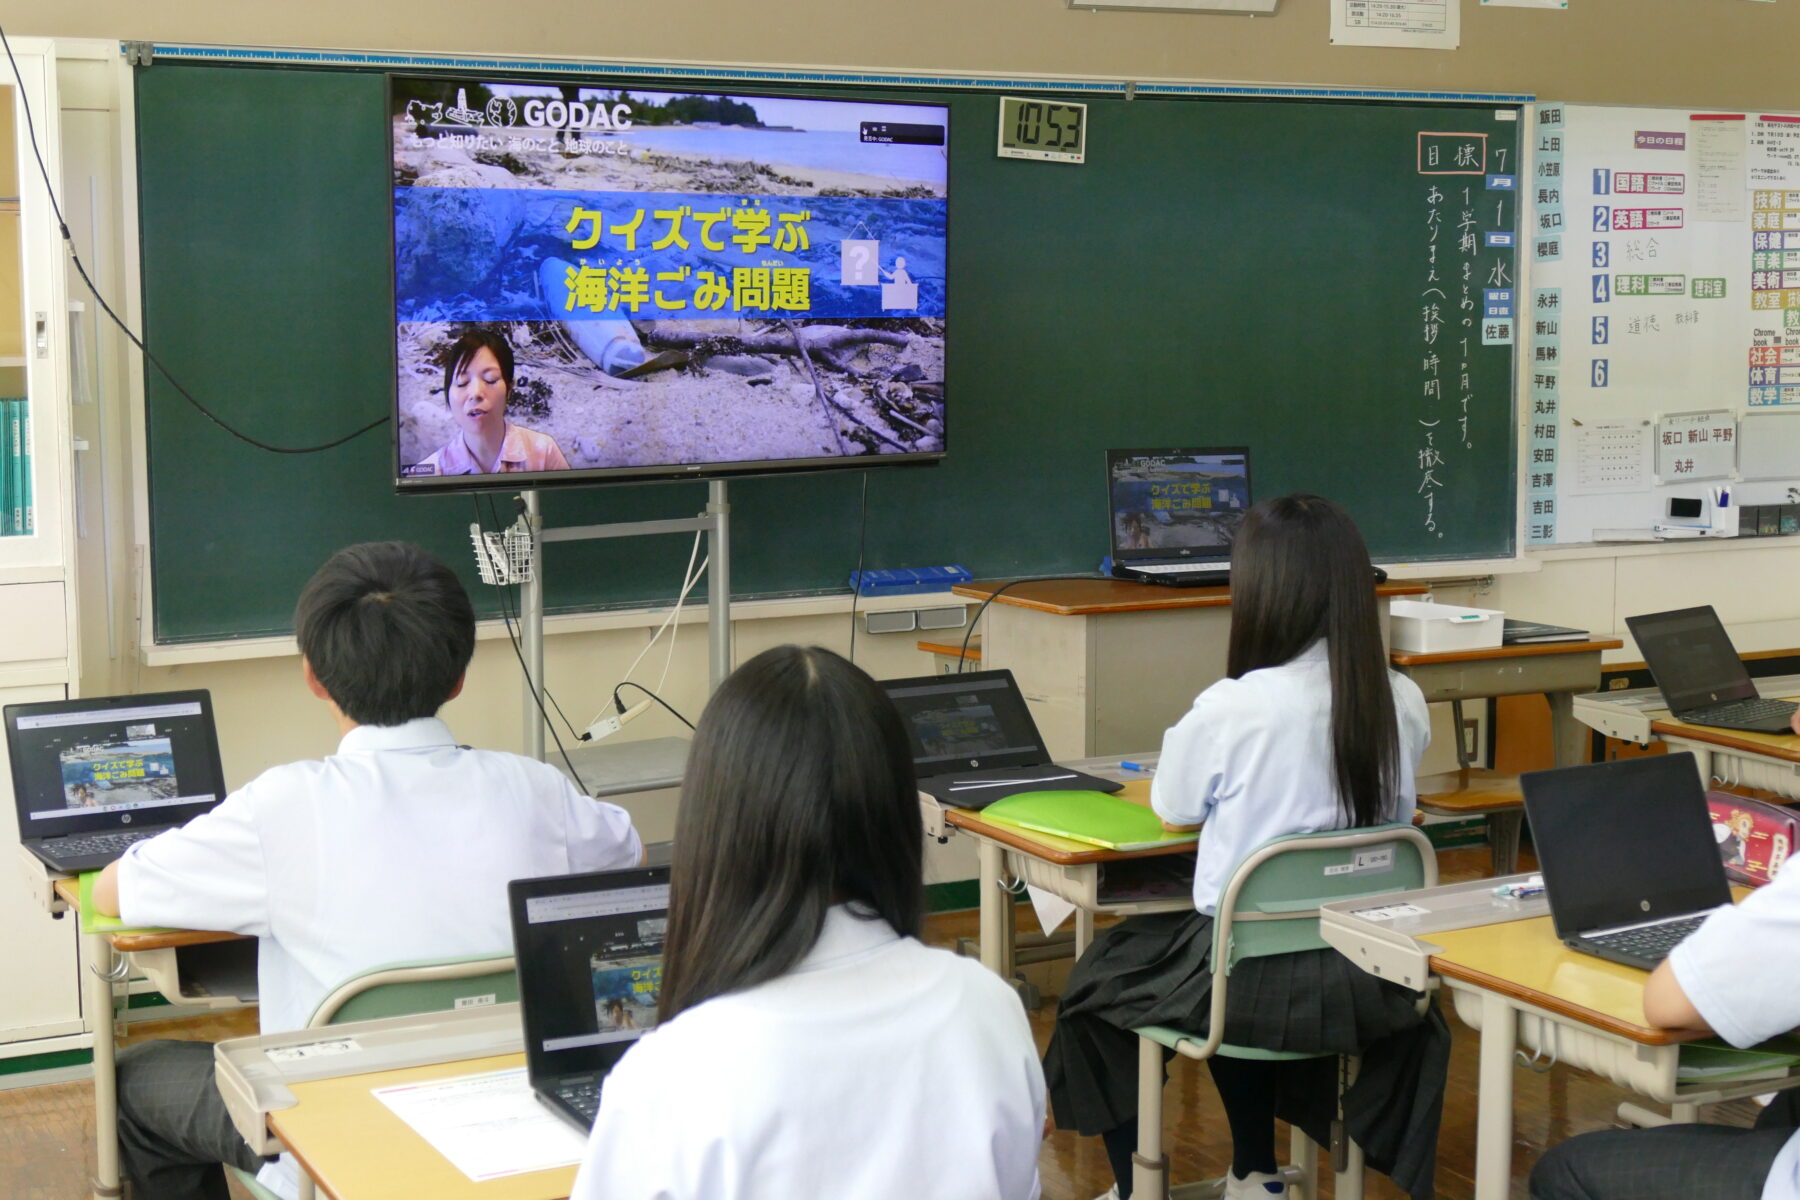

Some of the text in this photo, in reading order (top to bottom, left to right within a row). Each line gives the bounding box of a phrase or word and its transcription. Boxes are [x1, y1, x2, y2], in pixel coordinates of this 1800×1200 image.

[523, 99, 633, 130] GODAC
[1540, 109, 1561, 124] 飯田
[412, 132, 629, 156] もっと知りたい 海のこと 地球のこと
[1539, 136, 1560, 152] 上田
[1538, 162, 1560, 177] 小笠原
[1597, 169, 1606, 194] 1
[1616, 174, 1644, 192] 国語
[1537, 188, 1559, 204] 長内
[1540, 213, 1562, 229] 坂口
[1595, 206, 1608, 232] 2
[1614, 210, 1643, 228] 英語
[565, 206, 811, 253] クイズで学ぶ
[1627, 237, 1659, 261] 総合
[1755, 232, 1781, 250] 保健
[1595, 242, 1607, 267] 3
[1754, 252, 1780, 269] 音楽
[1595, 275, 1607, 302] 4
[1617, 276, 1645, 293] 理科
[1695, 280, 1723, 297] 理科室
[1753, 271, 1780, 289] 美術
[564, 265, 811, 313] 海洋ごみ問題
[1537, 293, 1558, 308] 永井
[1754, 291, 1780, 308] 教室
[1485, 324, 1509, 339] 佐藤
[1535, 320, 1557, 335] 新山
[1594, 316, 1606, 343] 5
[1754, 338, 1767, 346] book
[1785, 337, 1799, 346] book
[1751, 347, 1777, 365] 社会
[1534, 374, 1556, 390] 平野
[1594, 360, 1605, 387] 6
[1751, 367, 1777, 384] 体育
[1750, 386, 1777, 404] 数学
[1534, 400, 1556, 414] 丸井
[1534, 424, 1556, 439] 村田
[1662, 427, 1733, 445] 坂口 新山 平野
[1533, 448, 1554, 463] 安田
[1674, 458, 1694, 473] 丸井
[1531, 472, 1553, 488] 吉澤
[1532, 500, 1553, 515] 吉田
